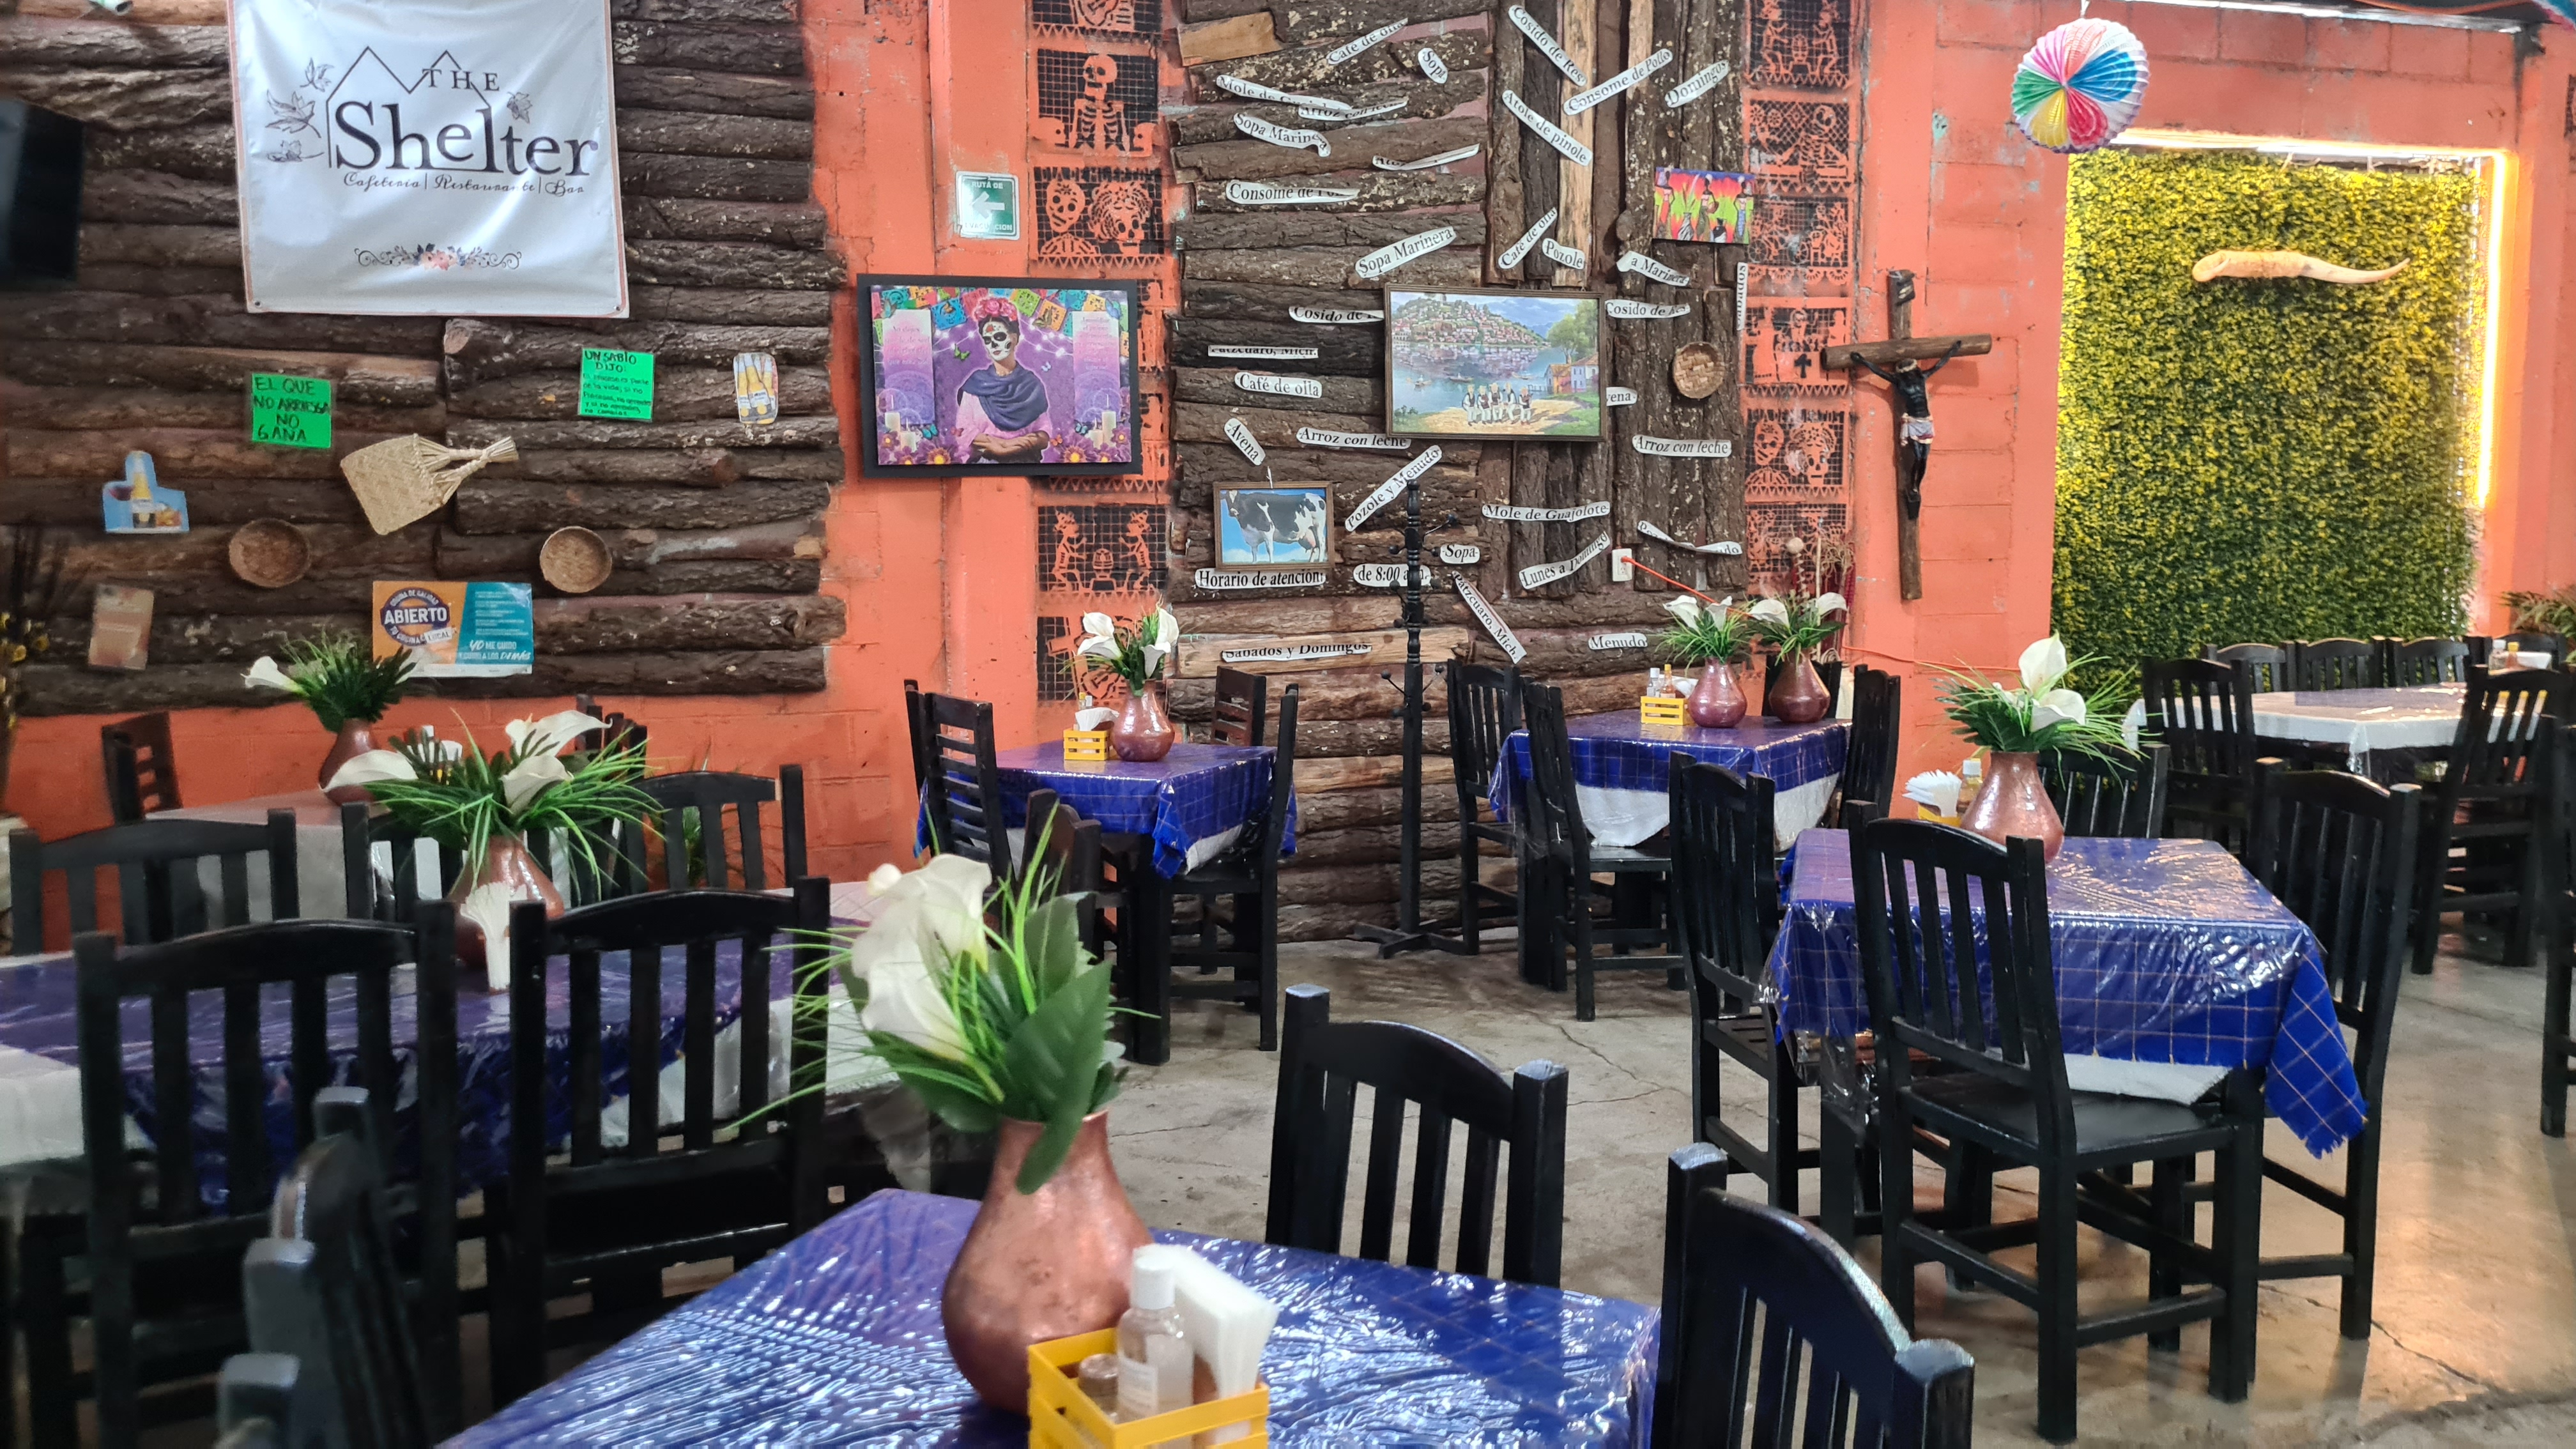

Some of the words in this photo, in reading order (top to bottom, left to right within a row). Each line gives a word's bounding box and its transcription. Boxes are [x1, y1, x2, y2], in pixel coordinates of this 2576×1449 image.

[1513, 7, 1549, 47] Cosido
[1548, 47, 1563, 63] de
[422, 68, 500, 91] THE
[1219, 76, 1255, 97] Mole
[1568, 76, 1630, 111] Consome
[1631, 66, 1646, 81] de
[1646, 50, 1671, 73] Pollo
[1234, 112, 1266, 135] Sopa
[1504, 93, 1534, 123] Atole
[1535, 119, 1551, 135] de
[1550, 132, 1587, 162] pinole
[335, 100, 599, 176] Shelter
[544, 179, 585, 197] Bar
[1526, 227, 1539, 243] de
[1359, 253, 1392, 274] Sopa
[1393, 228, 1453, 261] Marinera
[1545, 240, 1584, 268] Pozole
[1606, 302, 1646, 316] Cosido
[1650, 305, 1666, 316] de
[584, 350, 601, 361] UN
[602, 351, 637, 365] SABIO
[254, 376, 278, 391] EL
[282, 378, 316, 395] QUE
[1239, 373, 1271, 392] Café
[1274, 378, 1291, 394] de
[1294, 379, 1320, 397] olla
[254, 395, 275, 410] NO
[1607, 392, 1631, 402] vena
[276, 413, 300, 429] NO
[257, 424, 307, 443] GANA
[1227, 424, 1259, 461] Avena
[1344, 437, 1368, 446] con
[1372, 434, 1407, 448] leche
[1673, 441, 1694, 454] con
[1696, 440, 1729, 454] leche
[1347, 493, 1386, 530] Pozole
[1385, 486, 1395, 500] y
[1485, 505, 1521, 519] Mole
[1525, 509, 1541, 520] de
[1199, 570, 1248, 588] Horario
[1252, 570, 1268, 586] de
[1376, 565, 1400, 582] 8:00
[1521, 565, 1556, 587] Lunes
[1558, 565, 1566, 574] a
[384, 606, 448, 625] ABIERTO
[1286, 646, 1295, 659] y
[1493, 627, 1518, 660] Mich.
